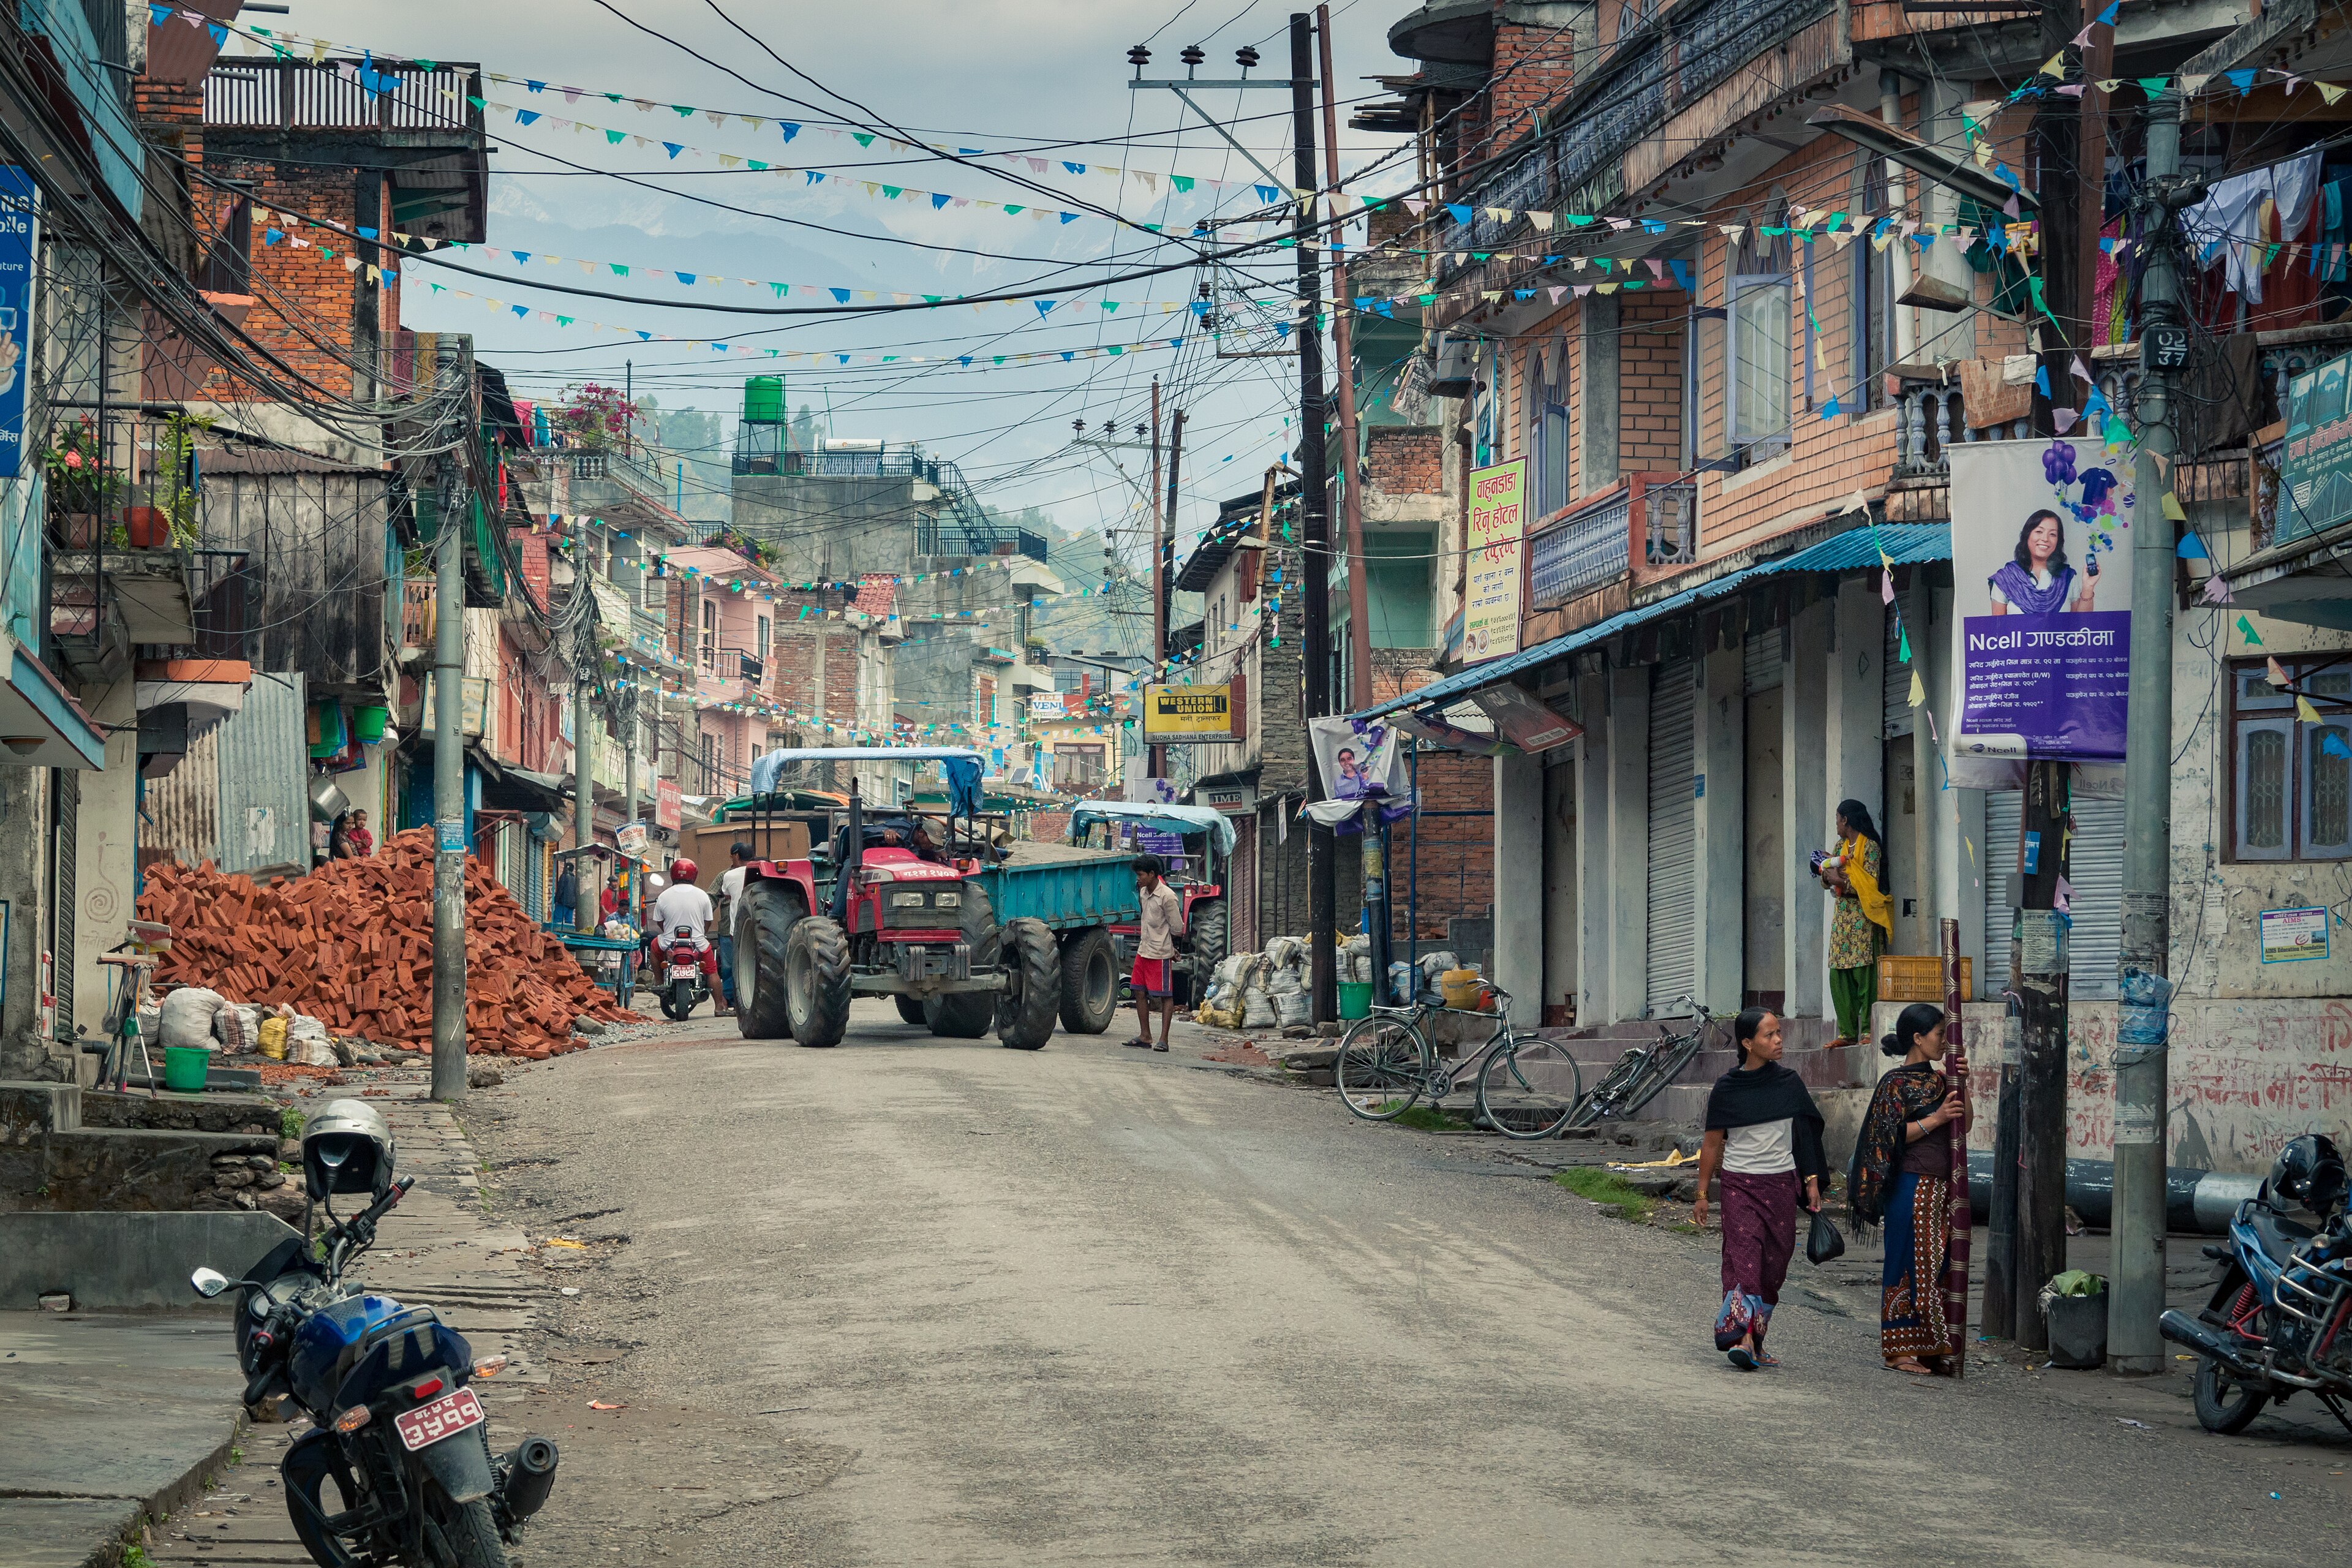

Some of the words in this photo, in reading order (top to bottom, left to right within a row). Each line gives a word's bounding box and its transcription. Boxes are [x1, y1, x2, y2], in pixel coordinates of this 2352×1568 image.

[2158, 331, 2185, 347] 02
[2158, 351, 2185, 366] 37
[1493, 502, 1518, 529] होटल
[1499, 570, 1502, 579] र
[1970, 631, 2021, 651] Ncell
[2026, 627, 2115, 647] गण्डकीमा
[1159, 696, 1213, 705] WESTERN
[1214, 794, 1241, 804] IME
